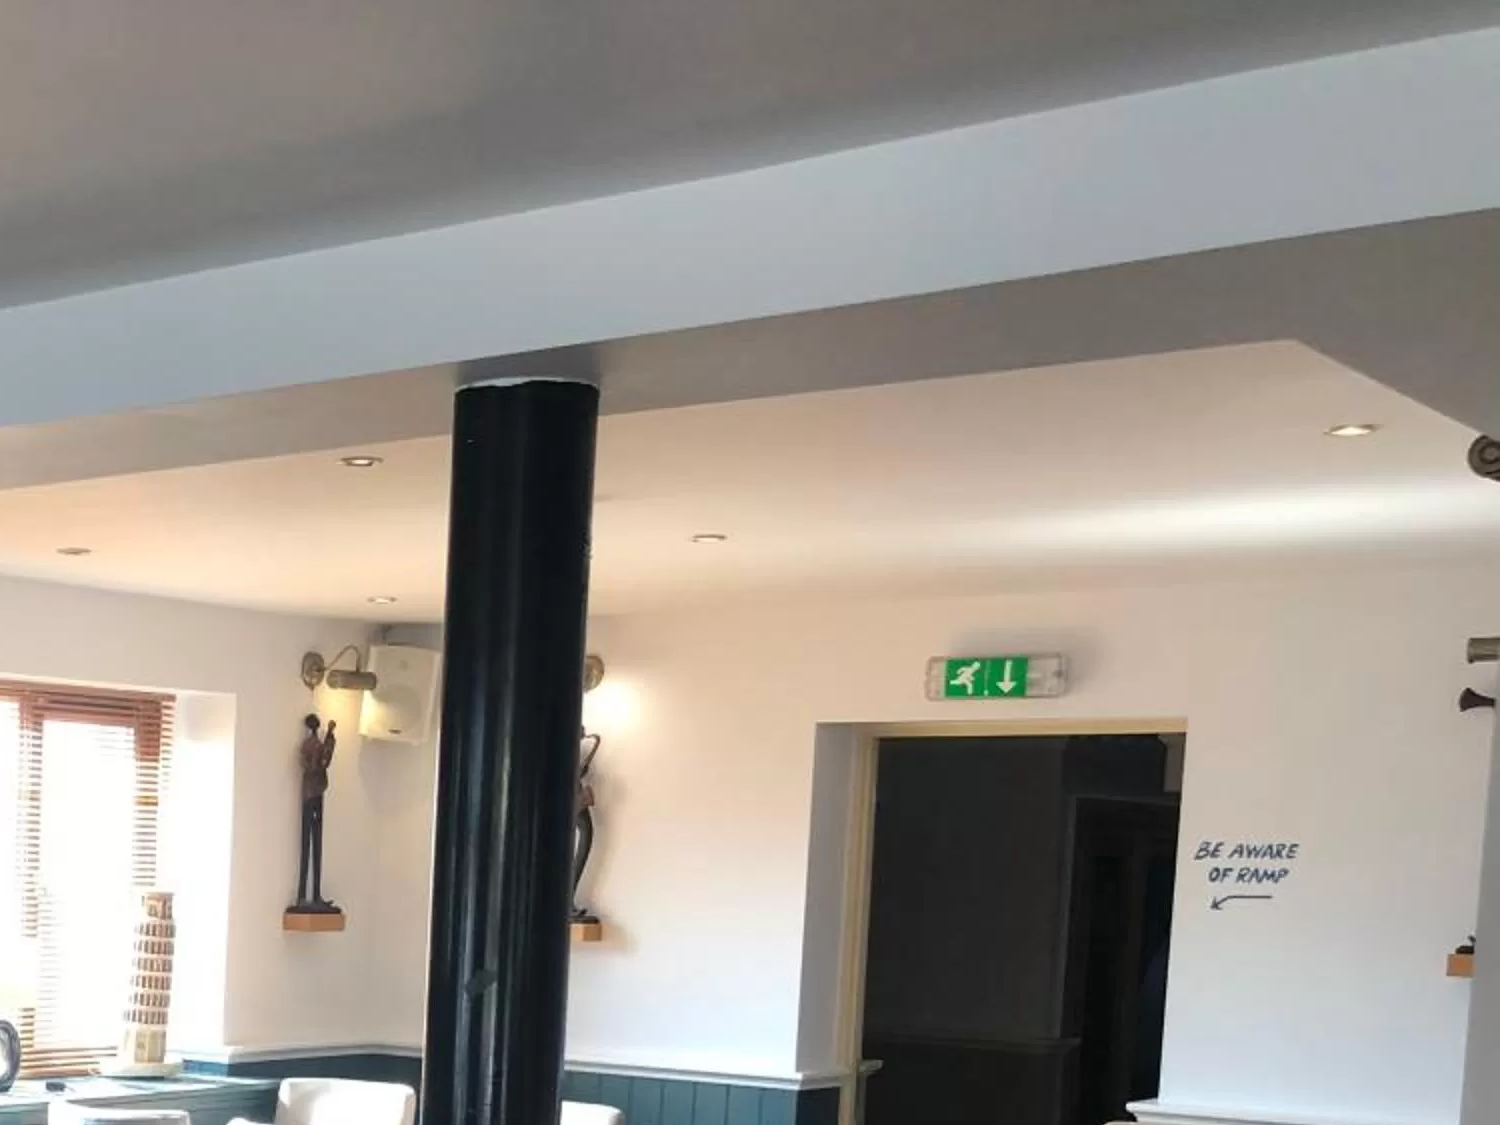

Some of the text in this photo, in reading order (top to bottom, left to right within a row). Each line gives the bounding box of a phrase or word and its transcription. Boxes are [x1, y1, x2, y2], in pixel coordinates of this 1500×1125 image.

[1194, 841, 1300, 861] BE AWARE
[1208, 866, 1290, 884] OF RAMP
